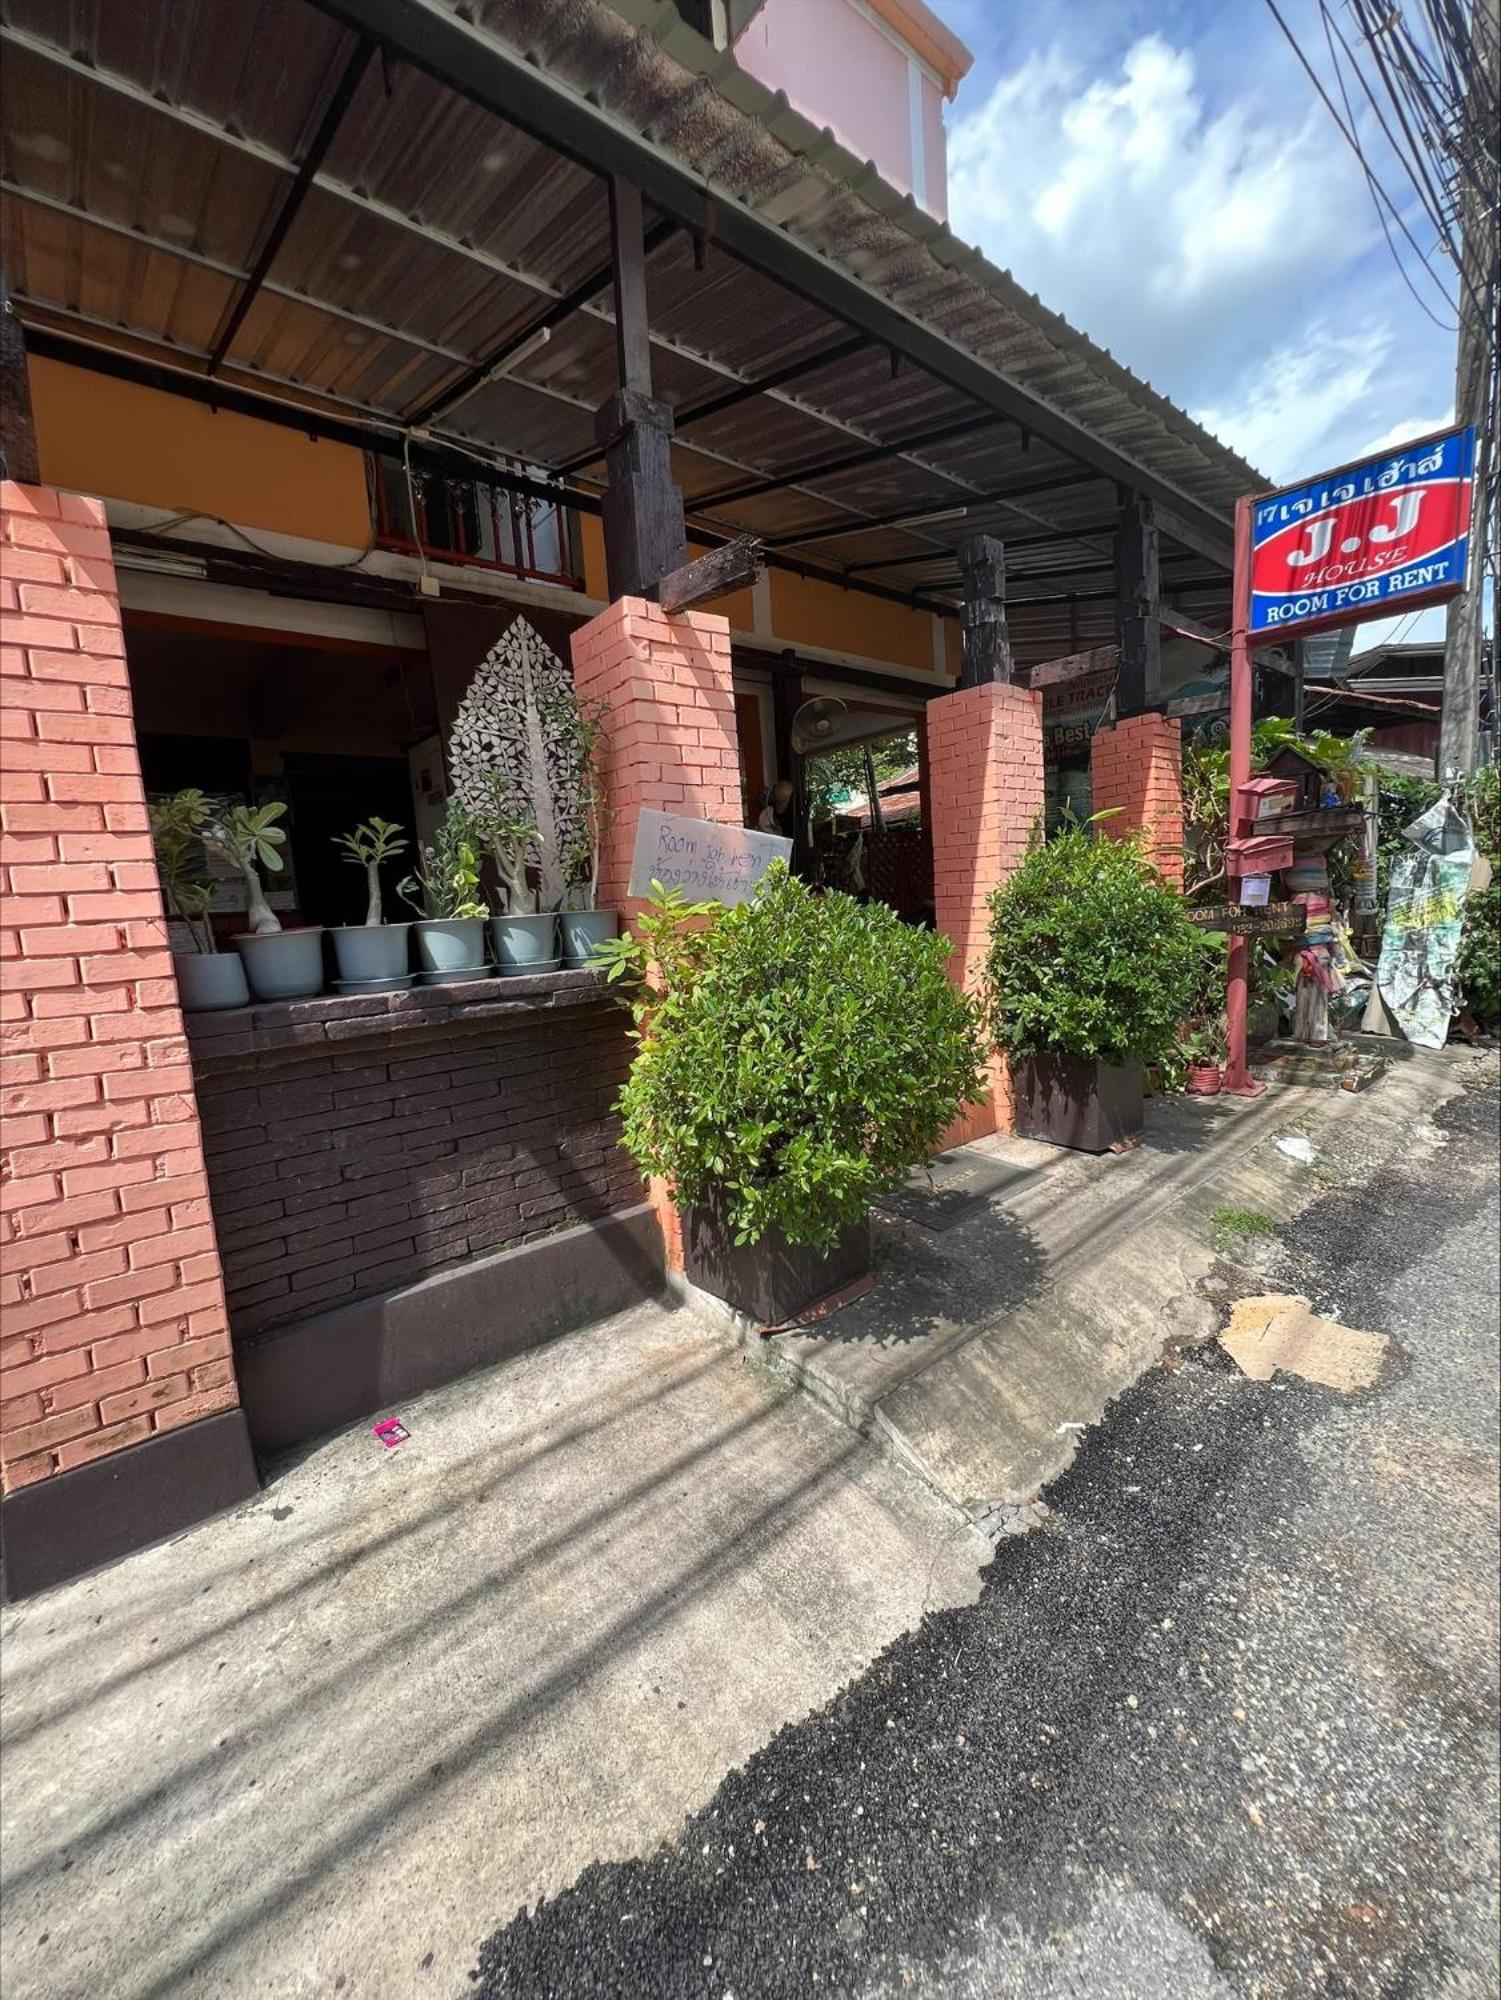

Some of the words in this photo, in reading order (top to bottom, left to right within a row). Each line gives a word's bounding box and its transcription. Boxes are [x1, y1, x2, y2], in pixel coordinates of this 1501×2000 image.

[1287, 490, 1428, 567] J.J
[1302, 546, 1408, 588] HOUSE
[1266, 594, 1329, 624] ROOM
[1335, 581, 1380, 606] FOR
[1388, 562, 1450, 592] RENT
[1054, 721, 1090, 745] Best
[658, 824, 697, 855] Room
